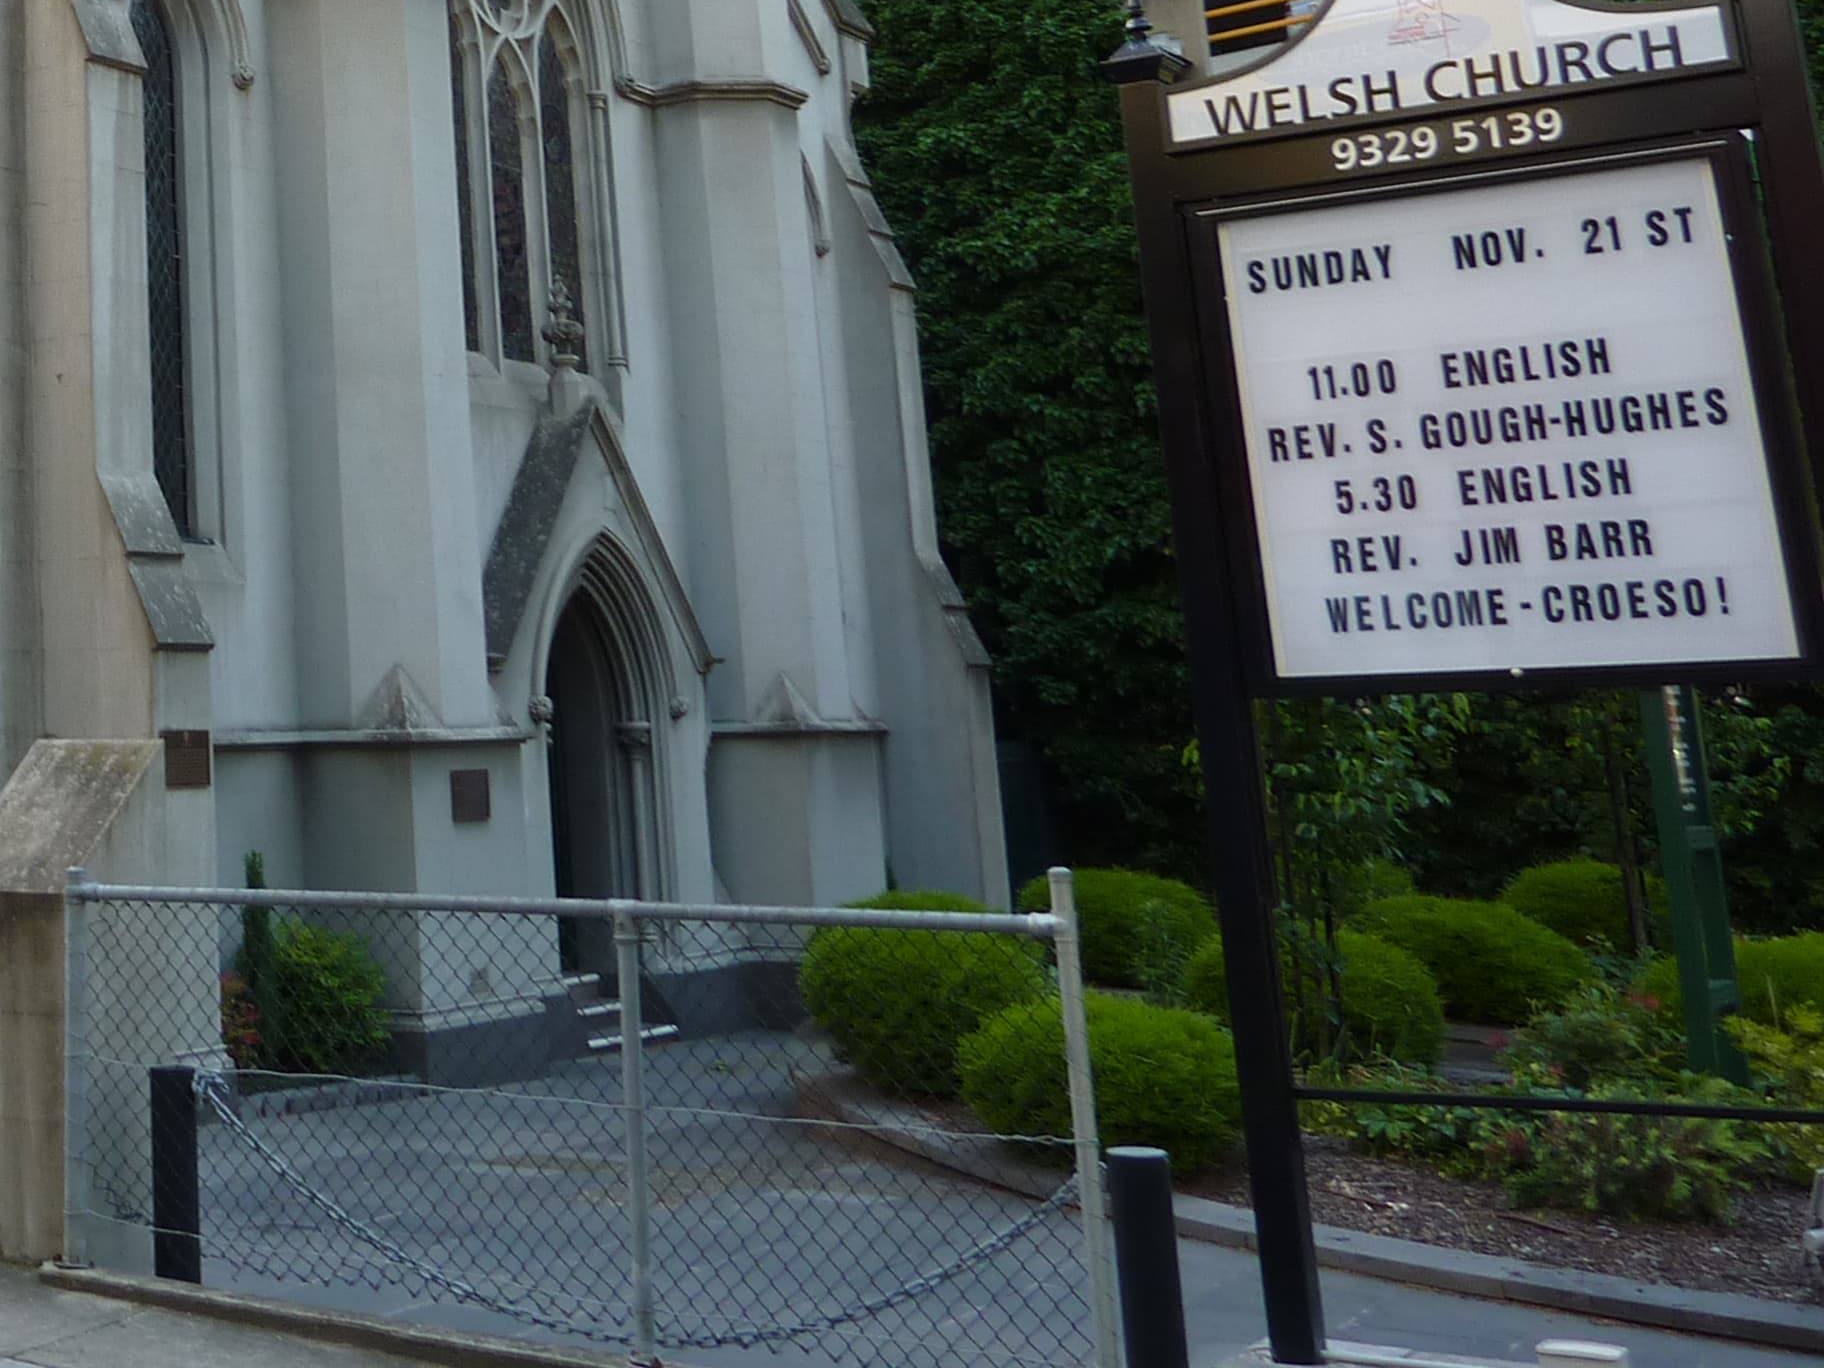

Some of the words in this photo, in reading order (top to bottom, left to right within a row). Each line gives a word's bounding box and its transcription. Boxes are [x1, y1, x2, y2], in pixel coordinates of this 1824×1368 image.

[1205, 70, 1400, 135] WELSH
[1423, 25, 1684, 103] CHURCH
[1330, 125, 1438, 171] 9329
[1453, 108, 1563, 154] 5139
[1247, 244, 1394, 294] SUNDAY
[1452, 227, 1545, 270] NOV.
[1581, 216, 1622, 256] 21
[1646, 207, 1694, 248] ST
[1307, 359, 1397, 401] 11.00
[1440, 338, 1611, 389] ENGLISH
[1268, 423, 1352, 463] REV.
[1368, 418, 1403, 454] S.
[1420, 388, 1729, 451] GOUGH-HUGHES
[1335, 474, 1418, 515] 5.30
[1458, 457, 1632, 507] ENGLISH
[1331, 537, 1419, 575] REV.
[1454, 527, 1521, 568] JIM
[1547, 519, 1654, 563] BARR
[1325, 588, 1507, 634] WELCOME
[1543, 576, 1731, 625] CROESO!
